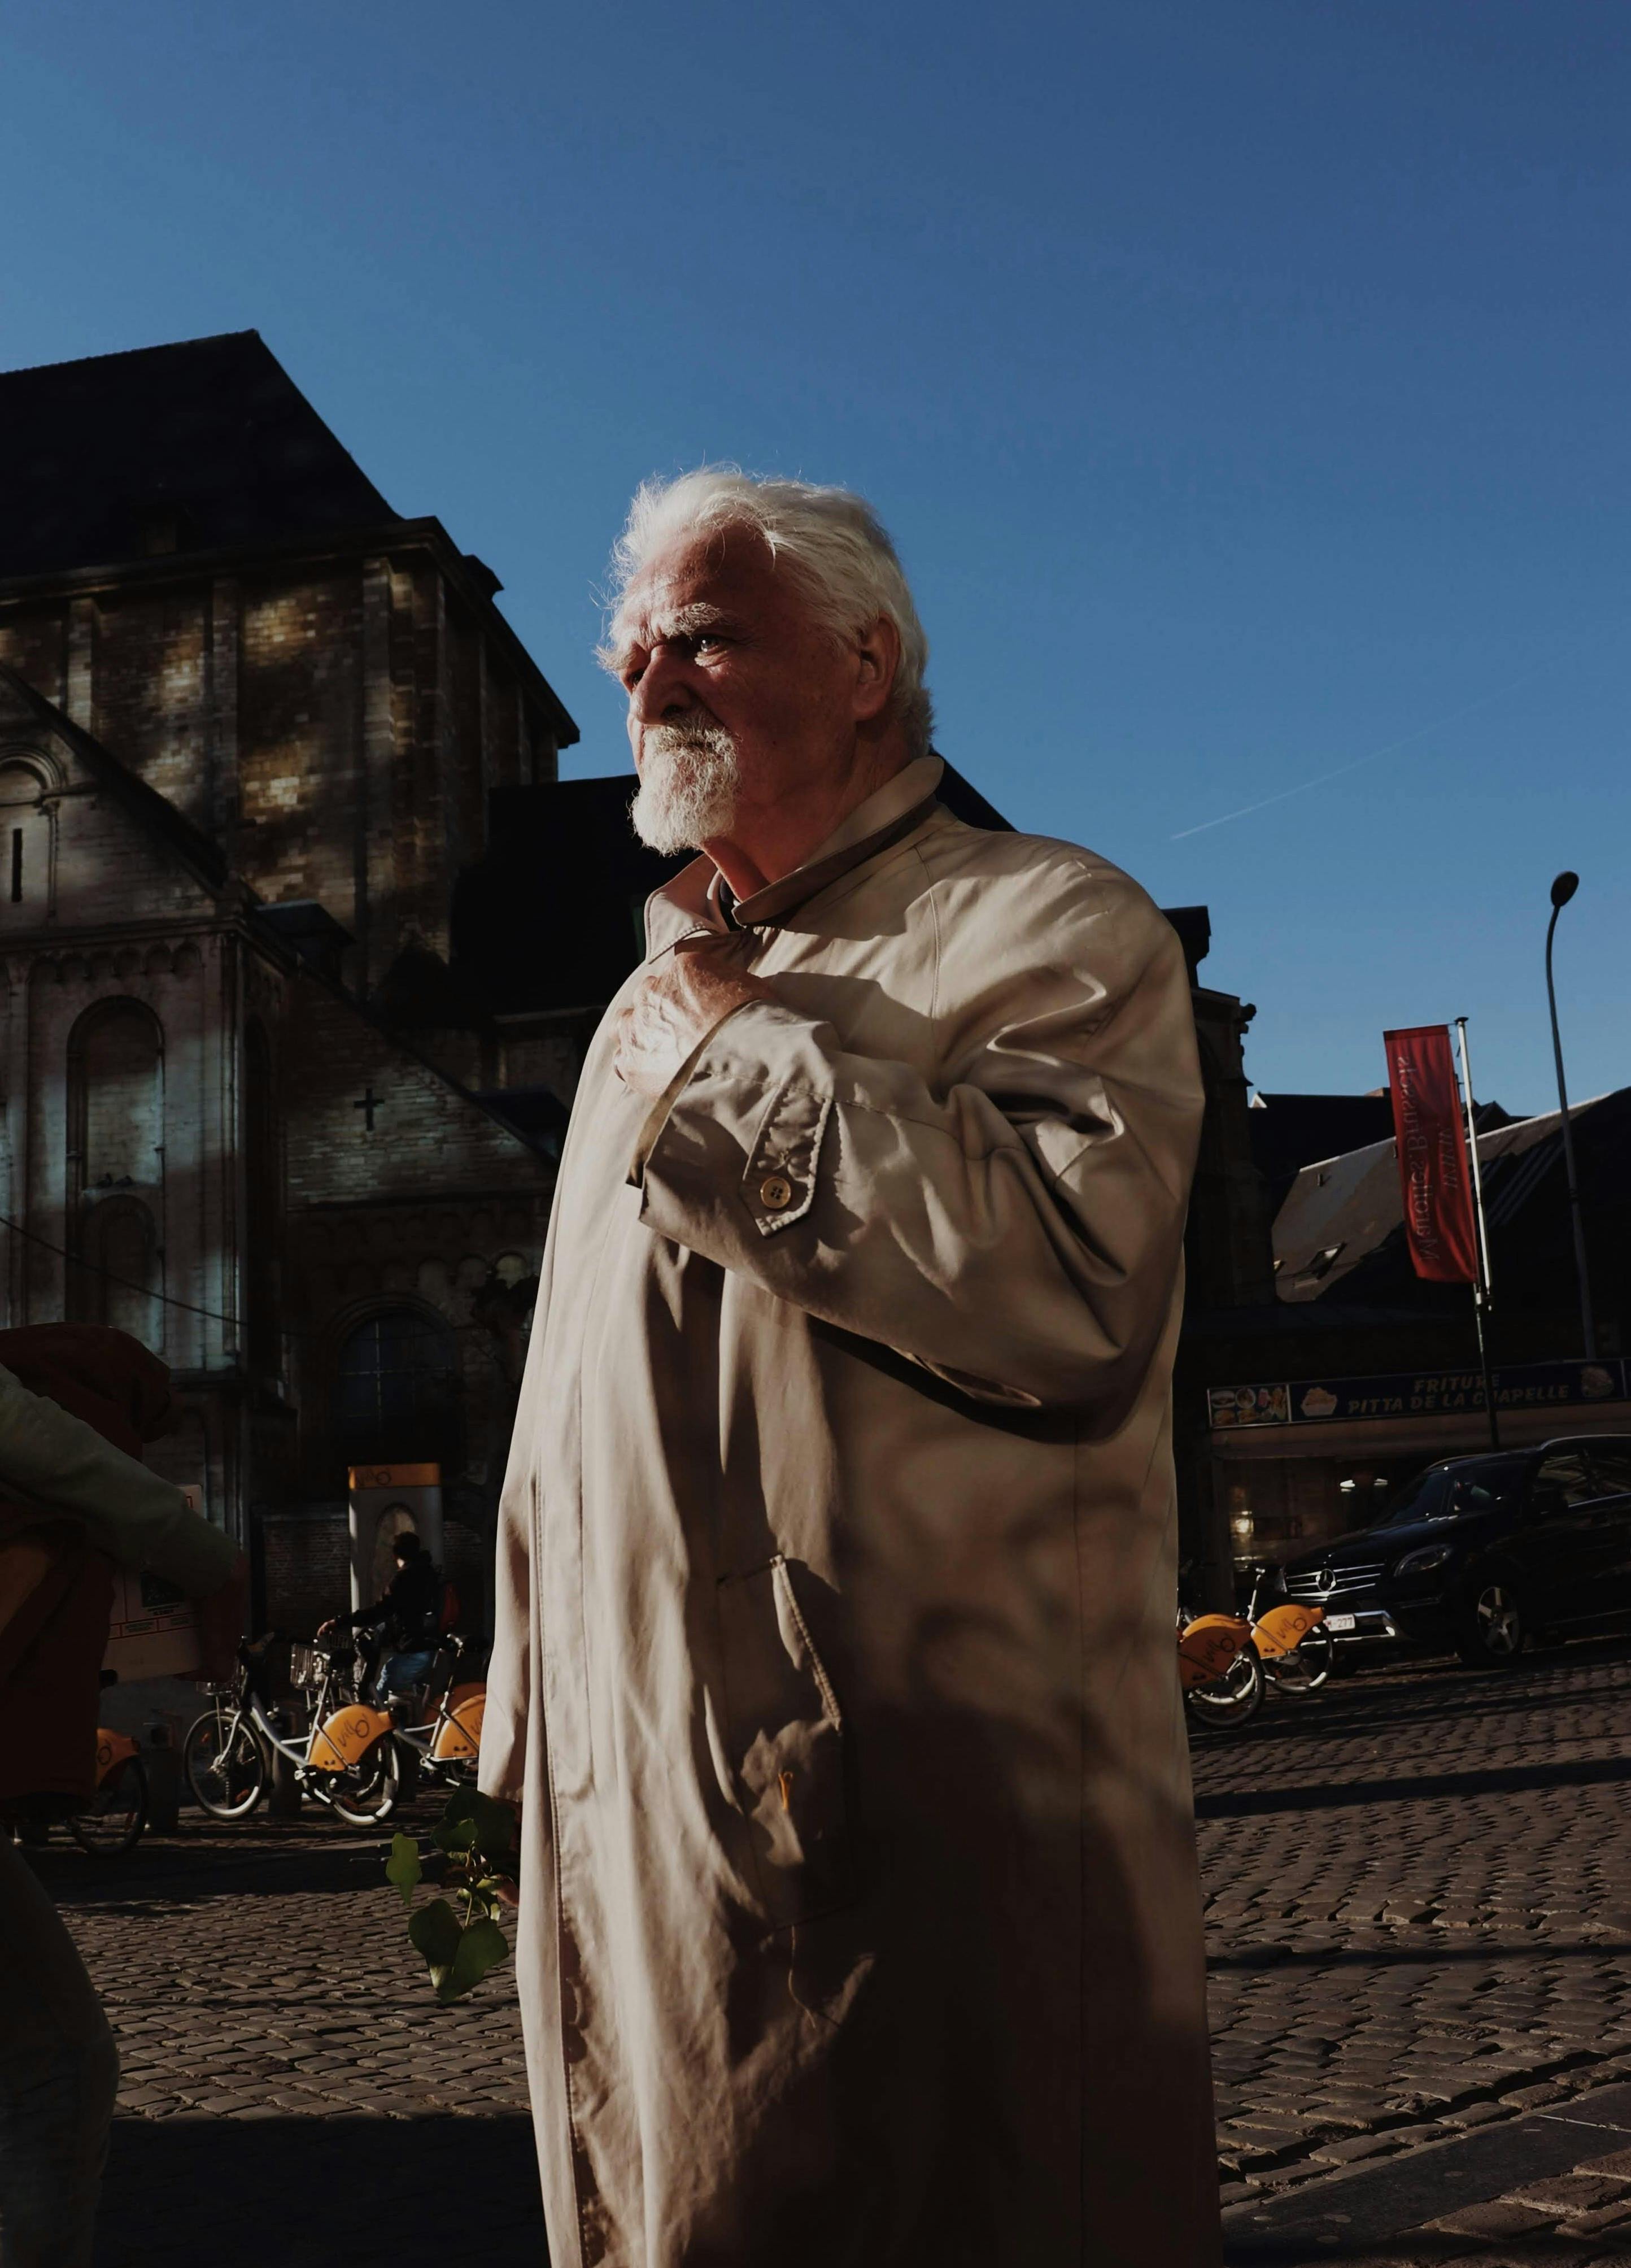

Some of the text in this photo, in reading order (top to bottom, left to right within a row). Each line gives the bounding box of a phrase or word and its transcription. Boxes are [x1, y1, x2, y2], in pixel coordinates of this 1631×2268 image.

[1348, 1398, 1403, 1414] PITTA
[1410, 1394, 1436, 1410] DE
[1442, 1392, 1465, 1408] LA
